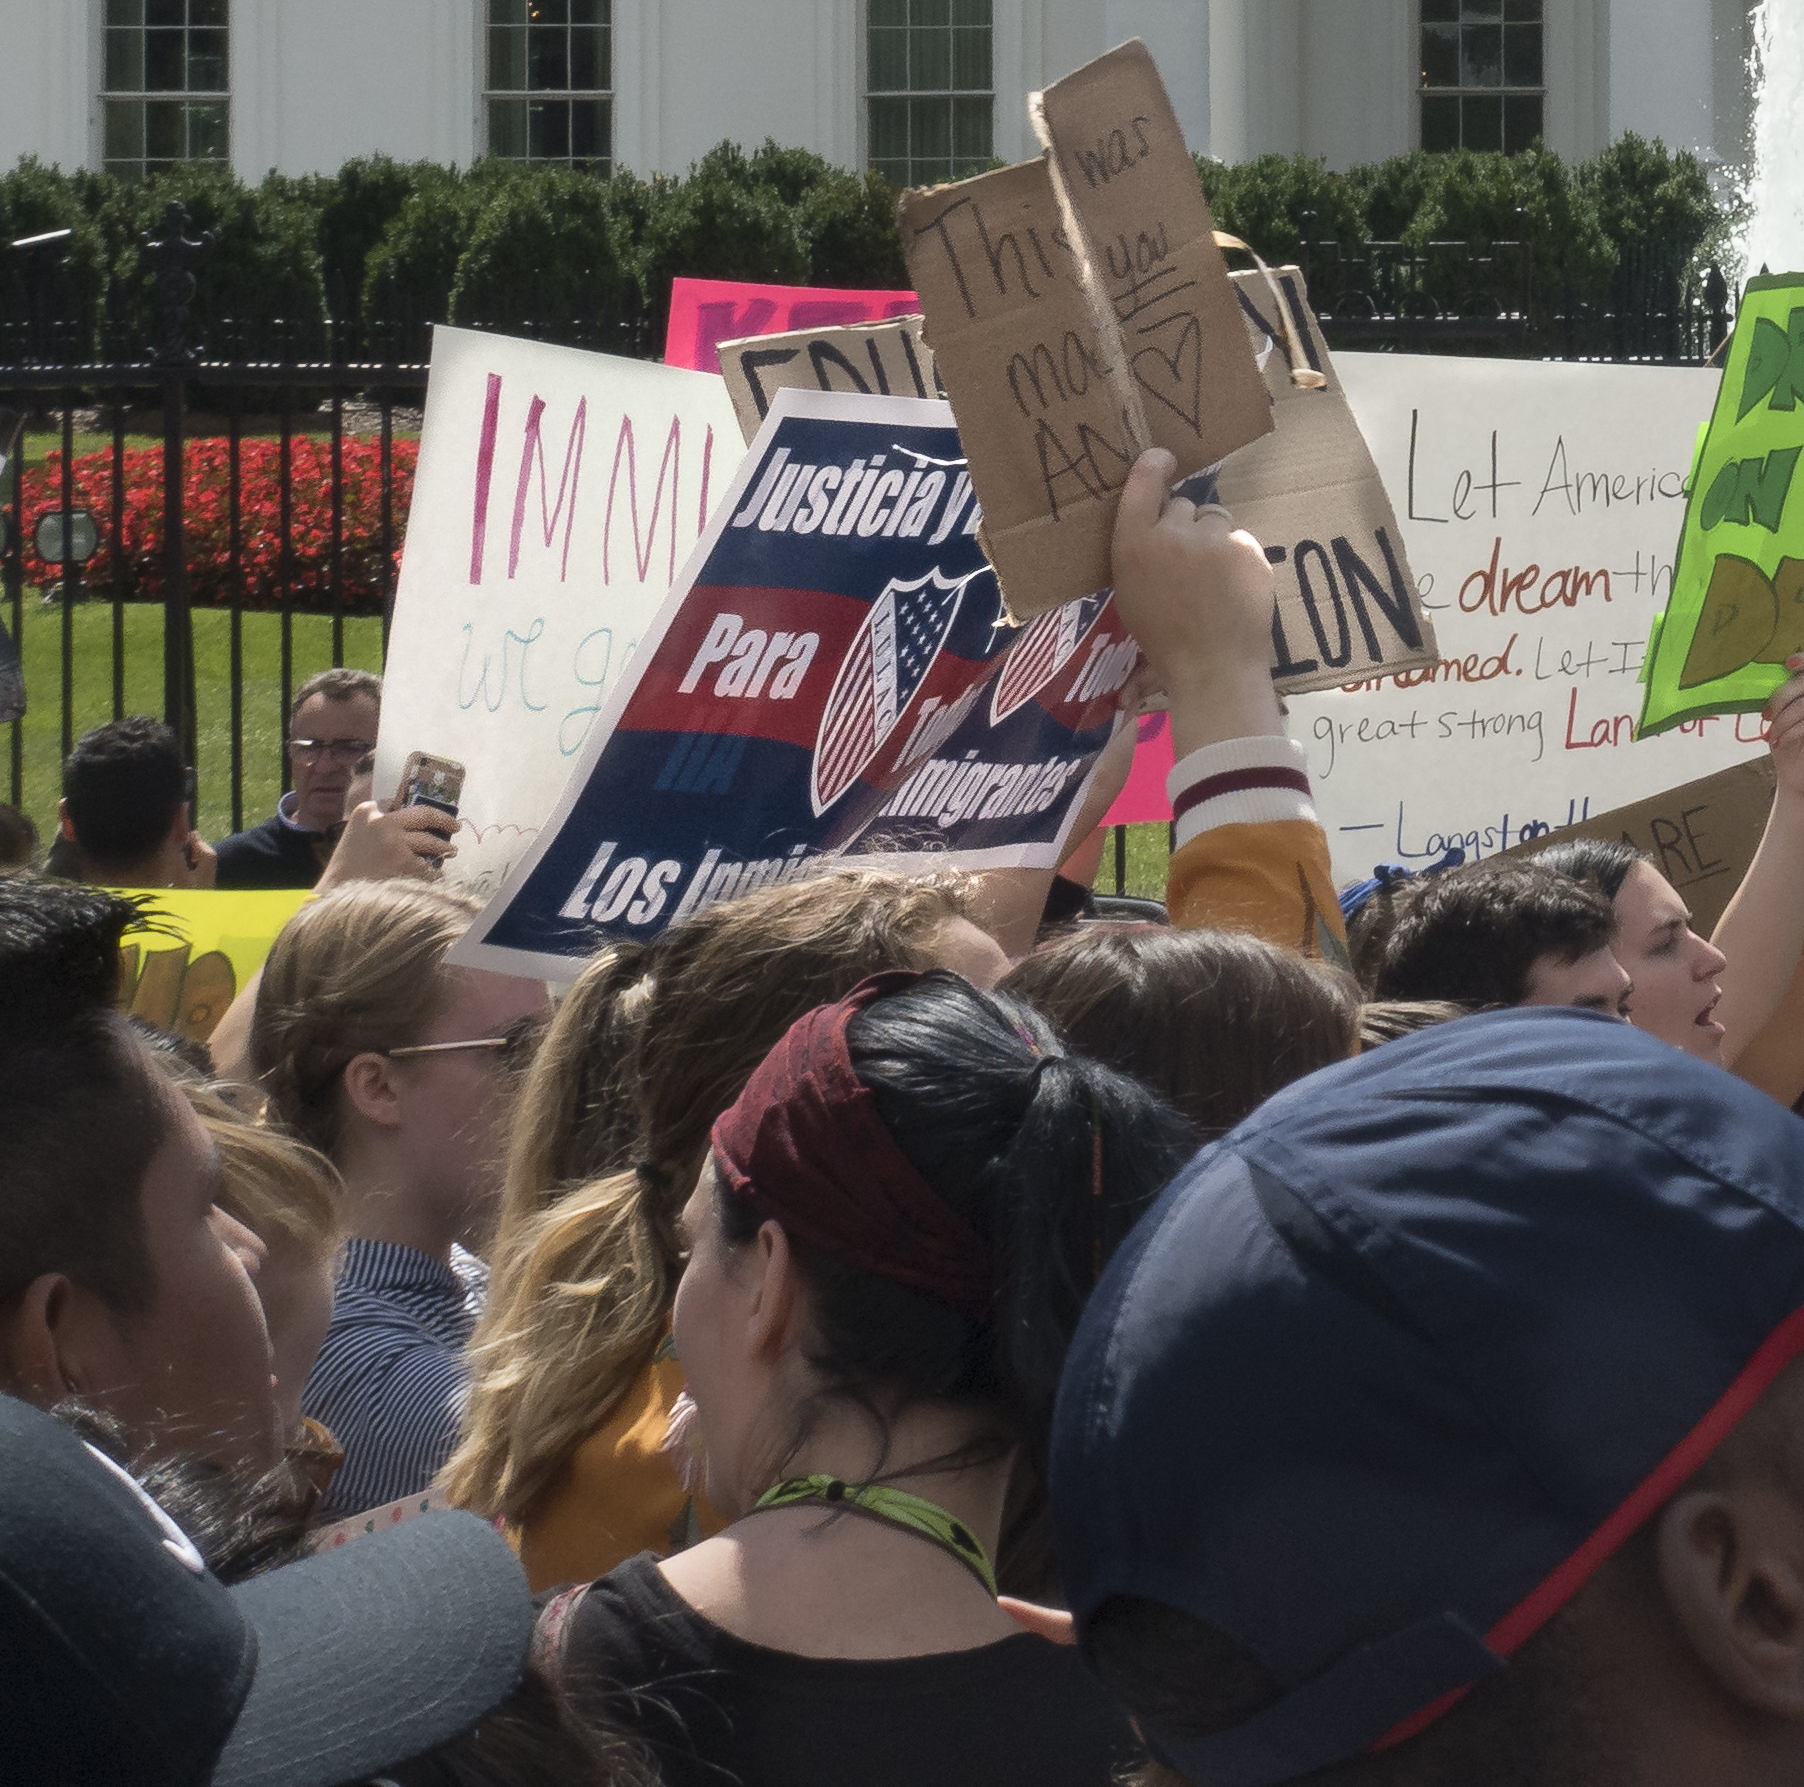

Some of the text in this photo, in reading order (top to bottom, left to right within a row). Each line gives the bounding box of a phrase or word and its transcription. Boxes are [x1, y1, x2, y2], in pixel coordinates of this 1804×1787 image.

[732, 447, 940, 537] Justicia
[1408, 408, 1521, 523] Let
[1459, 536, 1612, 616] dream
[677, 613, 820, 699] Para
[1536, 637, 1608, 681] Let
[1313, 710, 1428, 778] great
[1438, 708, 1543, 762] strong
[558, 842, 682, 925] Los
